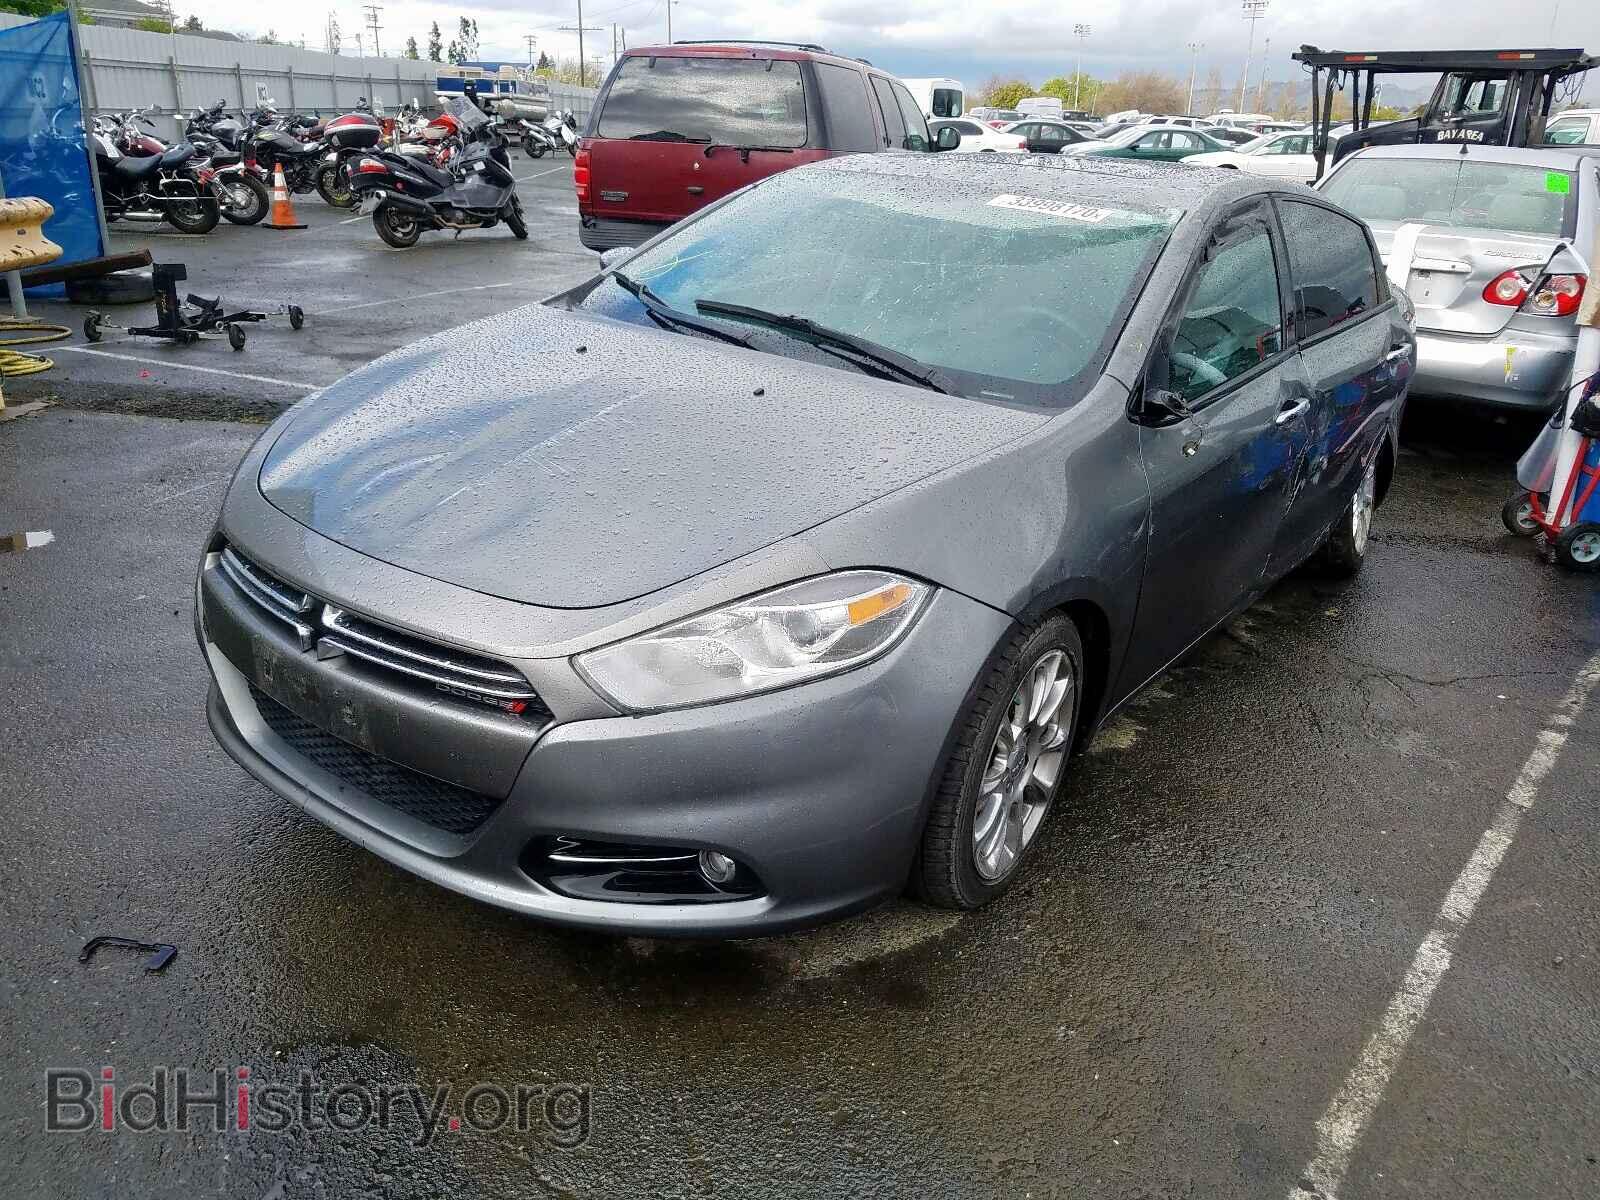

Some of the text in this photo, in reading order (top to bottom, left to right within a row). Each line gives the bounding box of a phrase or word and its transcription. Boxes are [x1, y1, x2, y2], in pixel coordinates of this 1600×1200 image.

[1437, 129, 1484, 142] BAY AREA
[435, 681, 513, 711] DODGE
